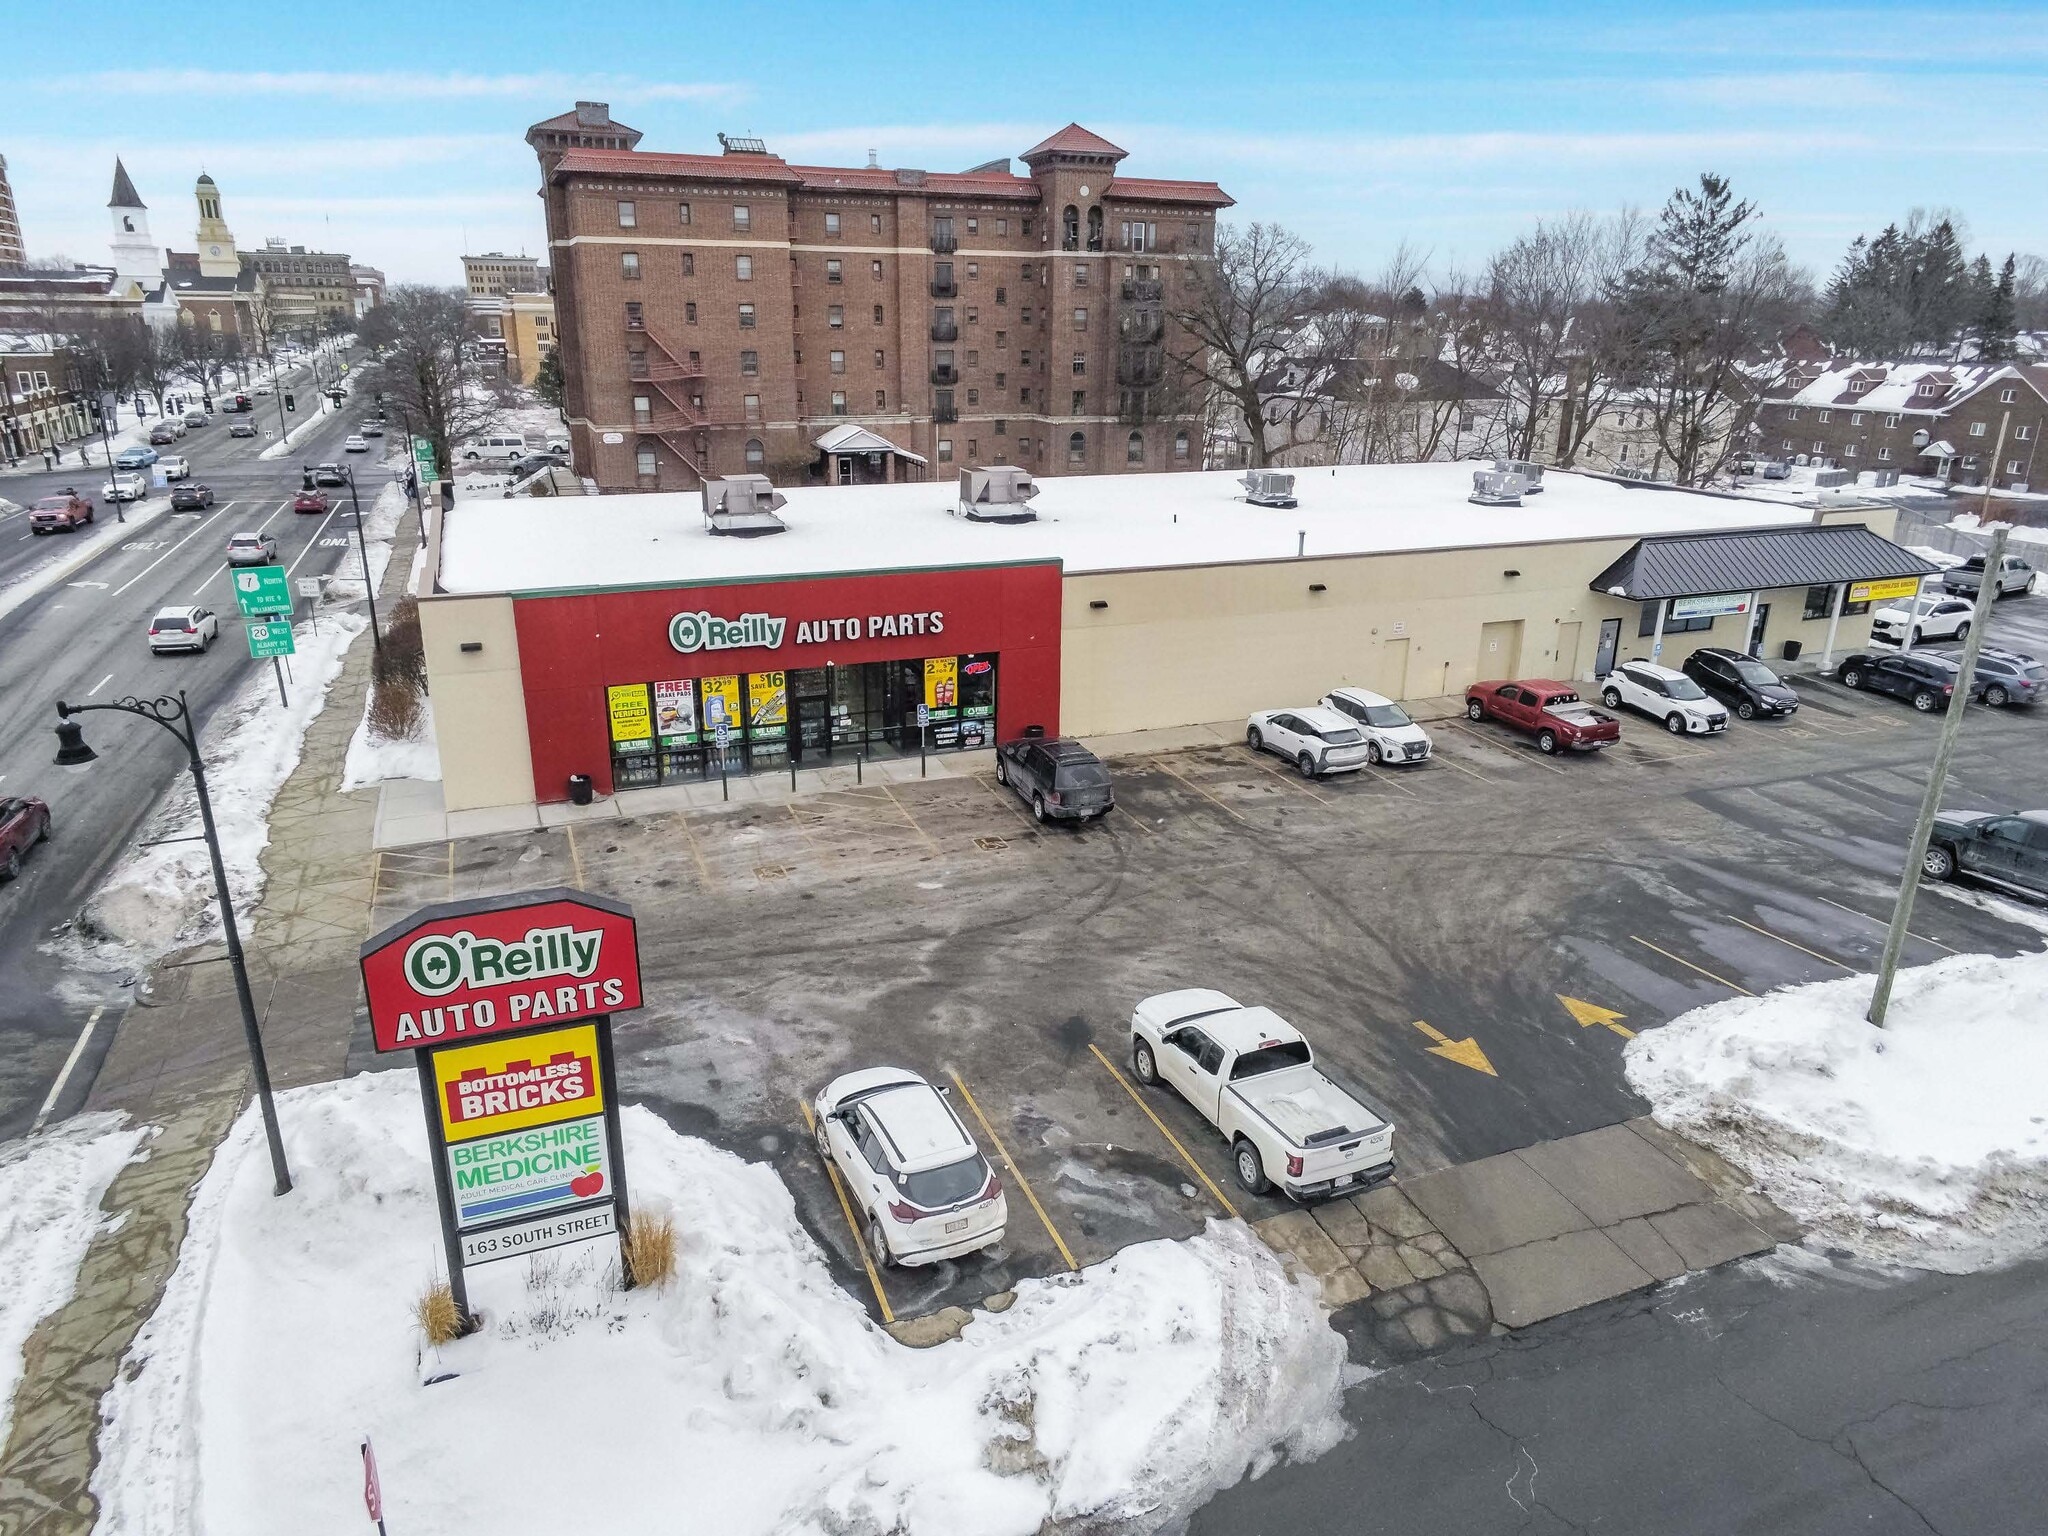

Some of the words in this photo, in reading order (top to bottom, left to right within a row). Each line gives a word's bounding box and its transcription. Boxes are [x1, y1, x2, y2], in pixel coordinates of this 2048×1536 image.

[319, 538, 349, 547] ONL
[247, 577, 252, 588] 7
[1678, 597, 1715, 607] BERKSHIRE
[253, 628, 267, 638] 20
[271, 627, 288, 635] WEST
[671, 613, 785, 651] O'Reilly
[795, 616, 861, 645] AUTO
[867, 611, 945, 638] PARTS
[256, 640, 278, 649] ALBANY
[274, 646, 288, 655] LEFT
[926, 663, 936, 675] 2
[967, 661, 989, 675] OPEN
[655, 680, 692, 693] FREE
[750, 682, 767, 690] SAVE
[676, 690, 692, 698] PADS
[614, 701, 644, 709] FREE
[614, 709, 646, 718] VERIFIED
[411, 932, 598, 991] O'Reilly
[395, 998, 498, 1044] AUTO
[508, 977, 625, 1024] PARTS
[458, 1060, 582, 1095] BOTTOMLESS
[460, 1076, 585, 1120] BRICKS
[453, 1121, 600, 1167] BERKSHIRE
[456, 1141, 602, 1191] MEDICINE
[460, 1188, 487, 1201] ADULT
[488, 1181, 525, 1194] MEDICAL
[527, 1177, 549, 1188] CARE
[550, 1171, 576, 1182] CLINIC
[466, 1239, 498, 1257] 163
[501, 1226, 553, 1249] SOUTH
[556, 1213, 611, 1236] STREET
